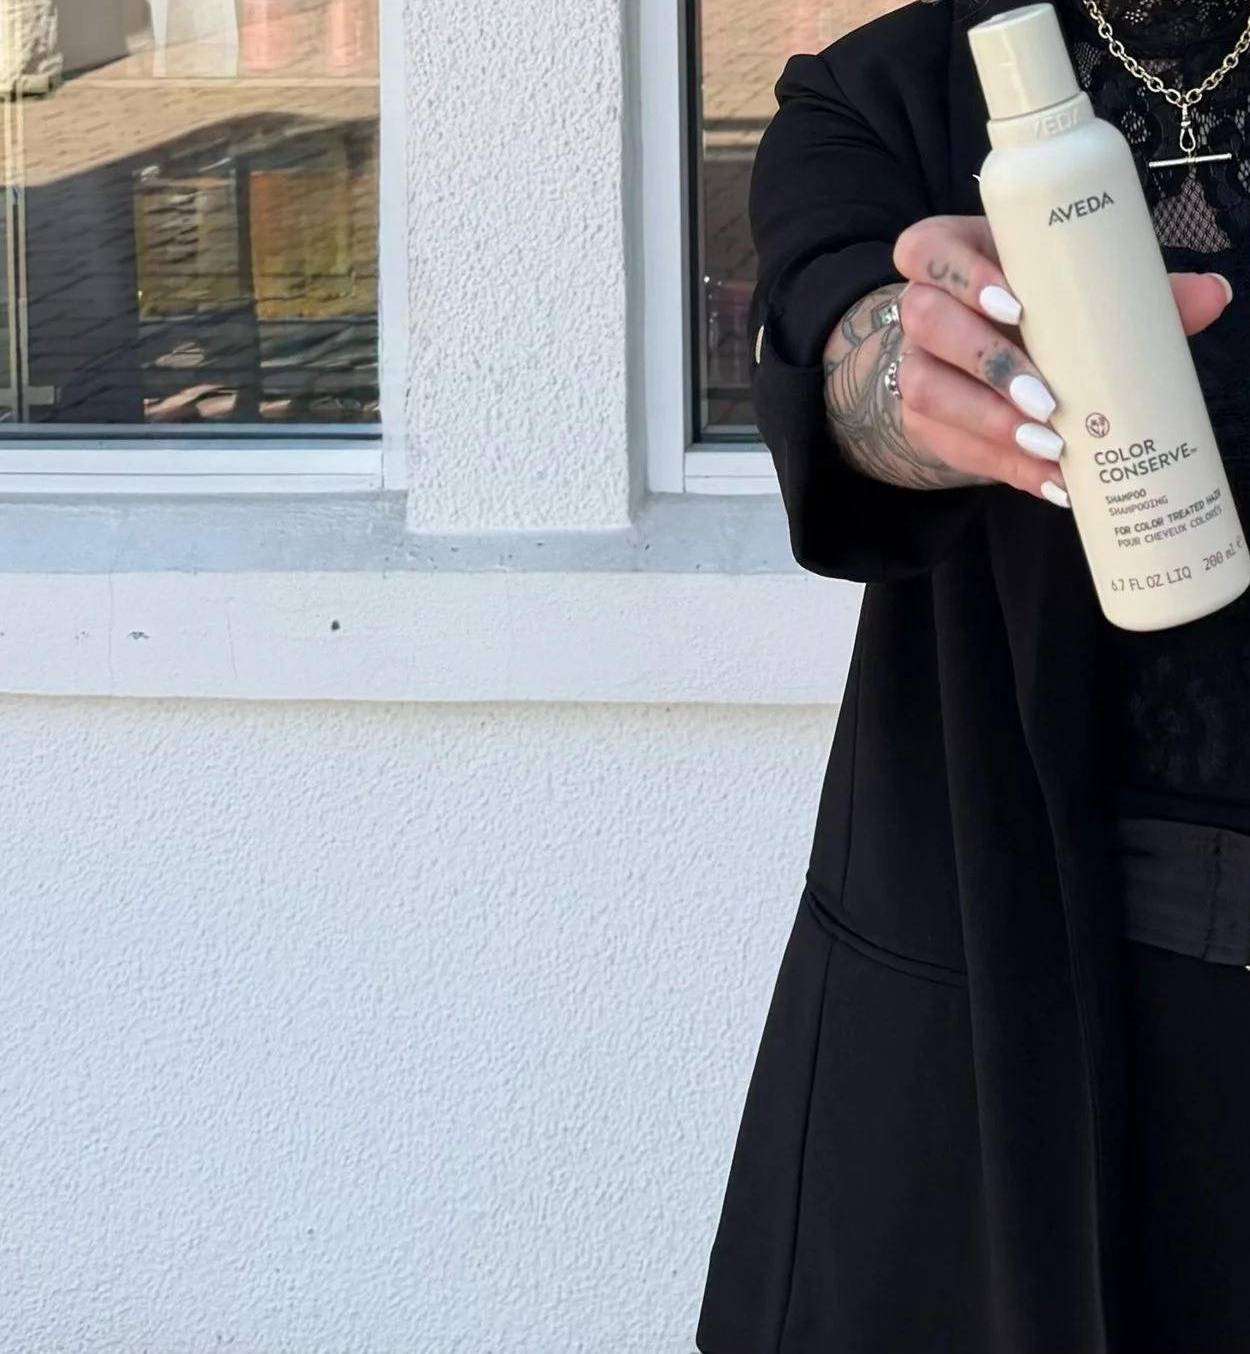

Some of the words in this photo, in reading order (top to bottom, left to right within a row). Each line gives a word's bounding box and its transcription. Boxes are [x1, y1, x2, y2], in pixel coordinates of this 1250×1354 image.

[1048, 191, 1115, 226] AVEDA
[1094, 439, 1156, 466] COLOR
[1105, 488, 1147, 505] SHAMPOO
[1108, 495, 1169, 517] SHAMPOOING
[1114, 525, 1131, 536] FOR
[1134, 517, 1165, 534] COLOR
[1168, 501, 1205, 523] TREATED
[1117, 536, 1141, 548] POUR
[1144, 524, 1187, 544] CHEVEUX
[1128, 577, 1145, 591] FL
[1146, 573, 1164, 589] OZ
[1166, 565, 1193, 584] LIQ
[1202, 551, 1224, 571] 200
